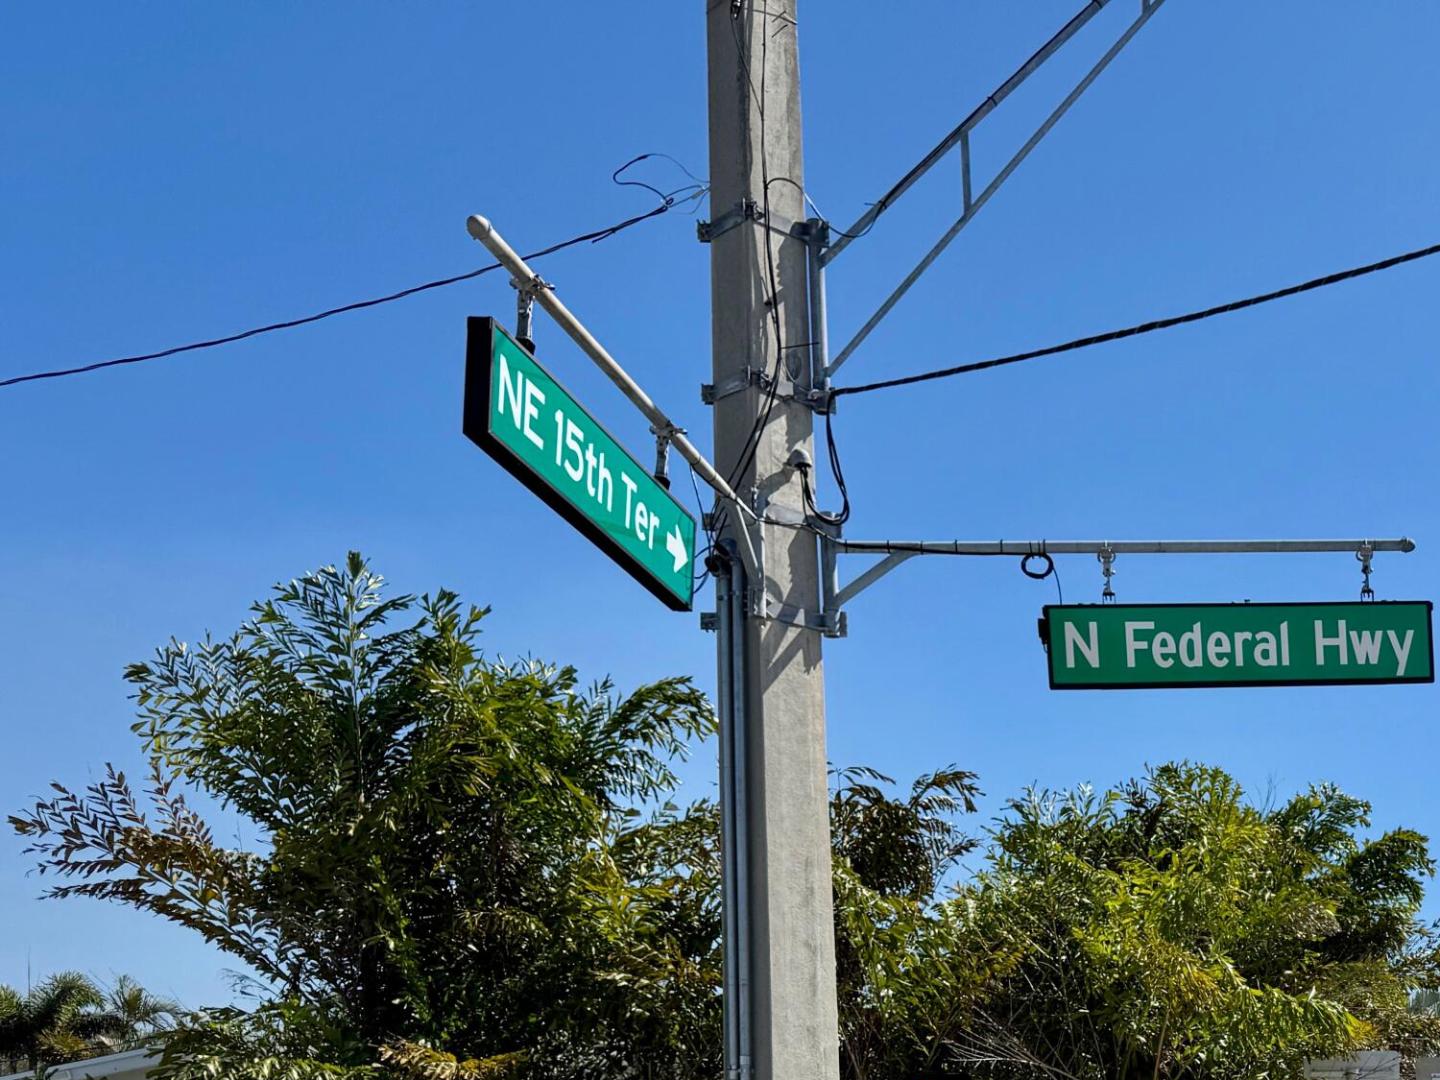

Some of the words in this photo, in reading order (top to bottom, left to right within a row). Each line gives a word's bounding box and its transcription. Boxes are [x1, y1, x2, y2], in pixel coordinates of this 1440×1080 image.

[498, 353, 546, 450] NE
[554, 408, 613, 512] 15th
[621, 471, 660, 550] Ter
[1063, 621, 1100, 669] N
[1124, 620, 1290, 669] Federal
[1314, 619, 1415, 677] Hwy
